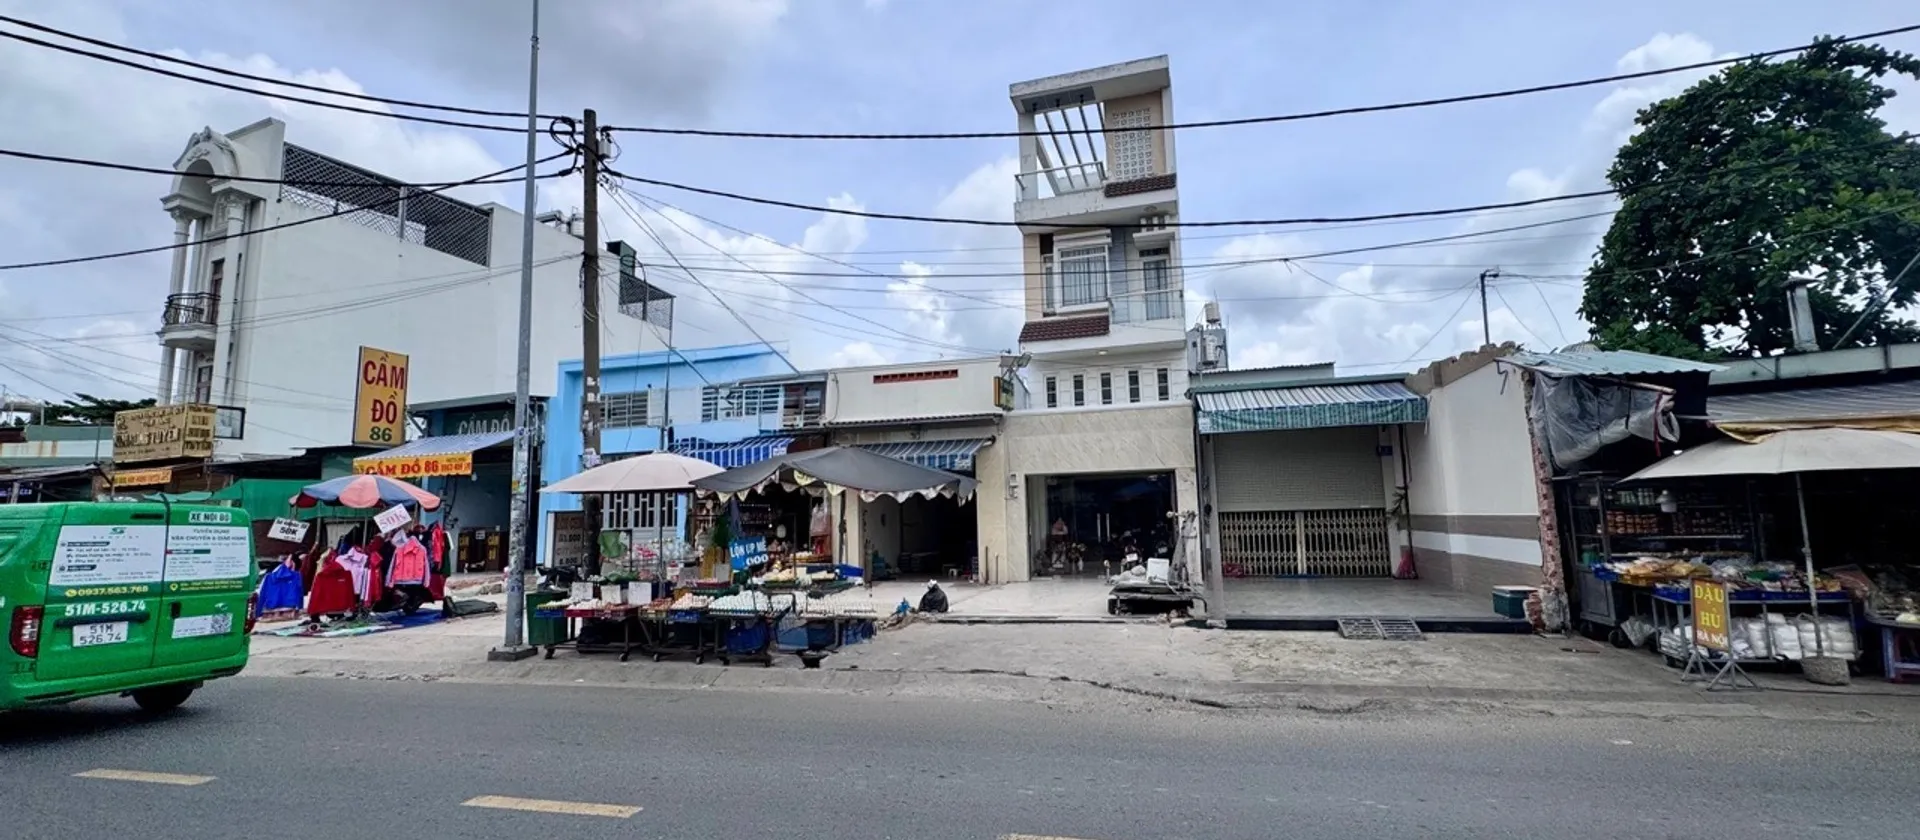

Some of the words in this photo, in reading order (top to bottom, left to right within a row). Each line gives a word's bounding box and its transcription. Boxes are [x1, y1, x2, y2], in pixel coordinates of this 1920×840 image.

[364, 352, 405, 390] CẦM
[371, 391, 397, 424] ĐỒ
[369, 426, 392, 441] 86
[423, 461, 439, 473] 86
[190, 512, 201, 521] XE
[65, 601, 145, 616] 51M-526.74
[90, 624, 113, 634] 51M
